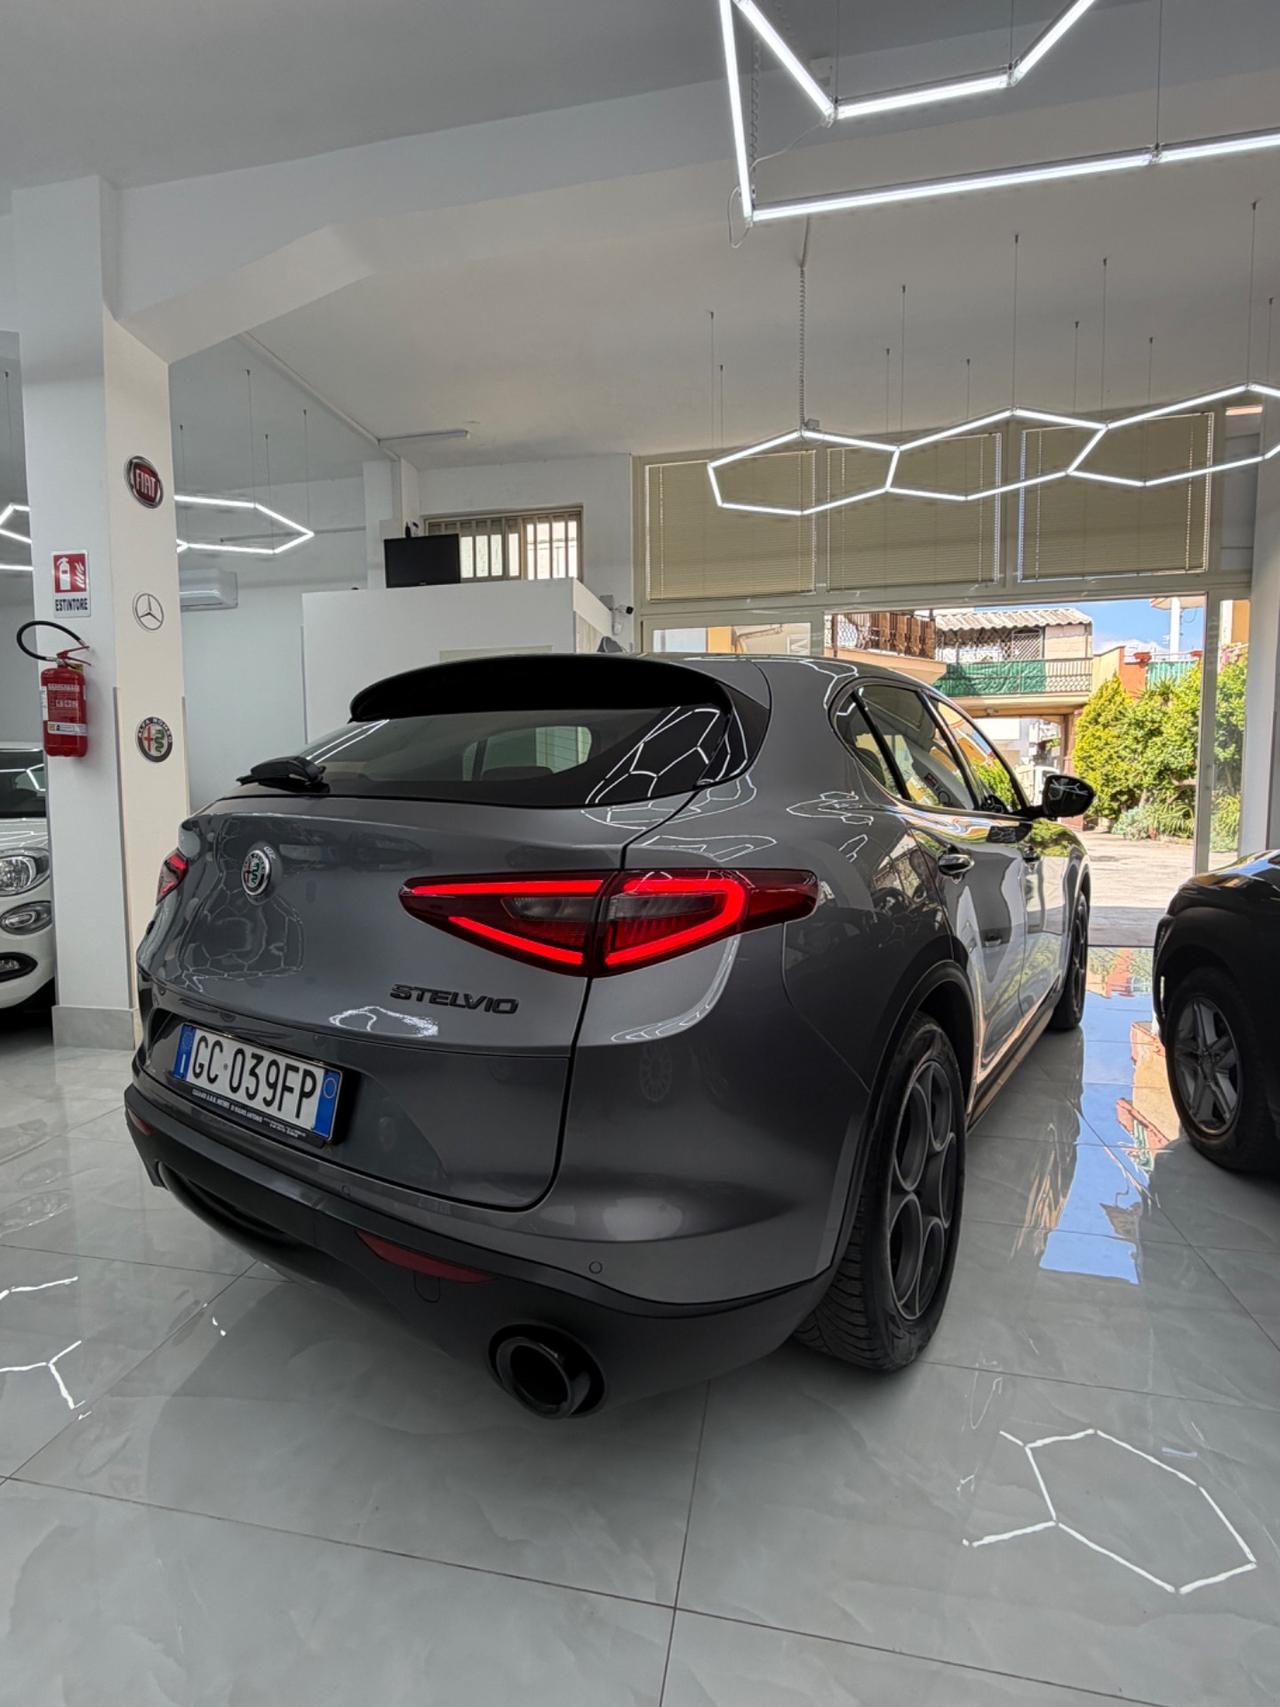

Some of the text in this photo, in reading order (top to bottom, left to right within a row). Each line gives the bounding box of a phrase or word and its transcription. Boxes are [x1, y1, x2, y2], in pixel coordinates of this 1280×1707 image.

[135, 469, 156, 498] FIAT
[55, 598, 88, 611] ESTINTORE
[390, 984, 519, 1014] STELVIO
